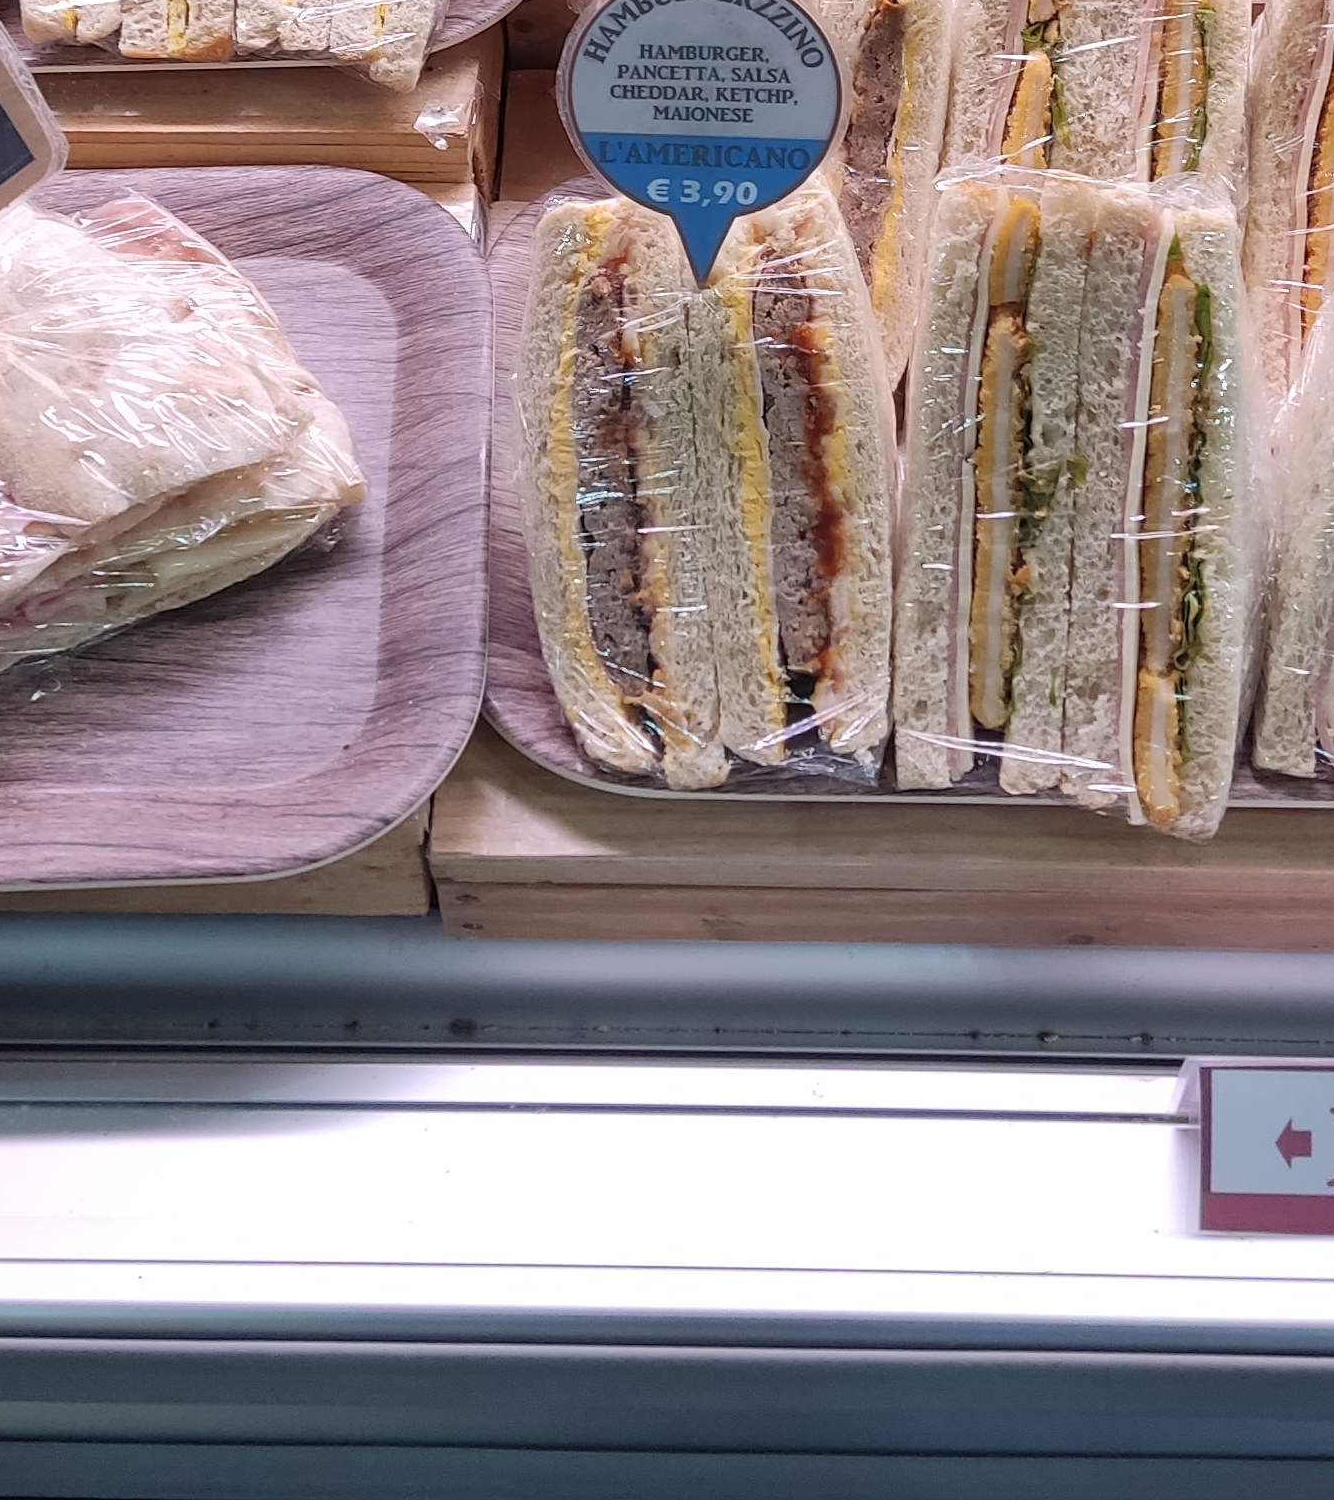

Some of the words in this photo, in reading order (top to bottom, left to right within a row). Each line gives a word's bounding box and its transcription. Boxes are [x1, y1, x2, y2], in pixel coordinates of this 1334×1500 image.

[638, 44, 769, 64] HAMBURGER,
[617, 64, 725, 83] PANCETTA,
[731, 67, 791, 84] SALSA
[610, 85, 709, 103] CHEDDAR,
[715, 87, 798, 106] KETCHP,
[652, 105, 754, 123] MAIONESE
[598, 141, 811, 170] L'AMERICANO
[646, 179, 670, 203] €
[679, 180, 758, 208] 3,90
